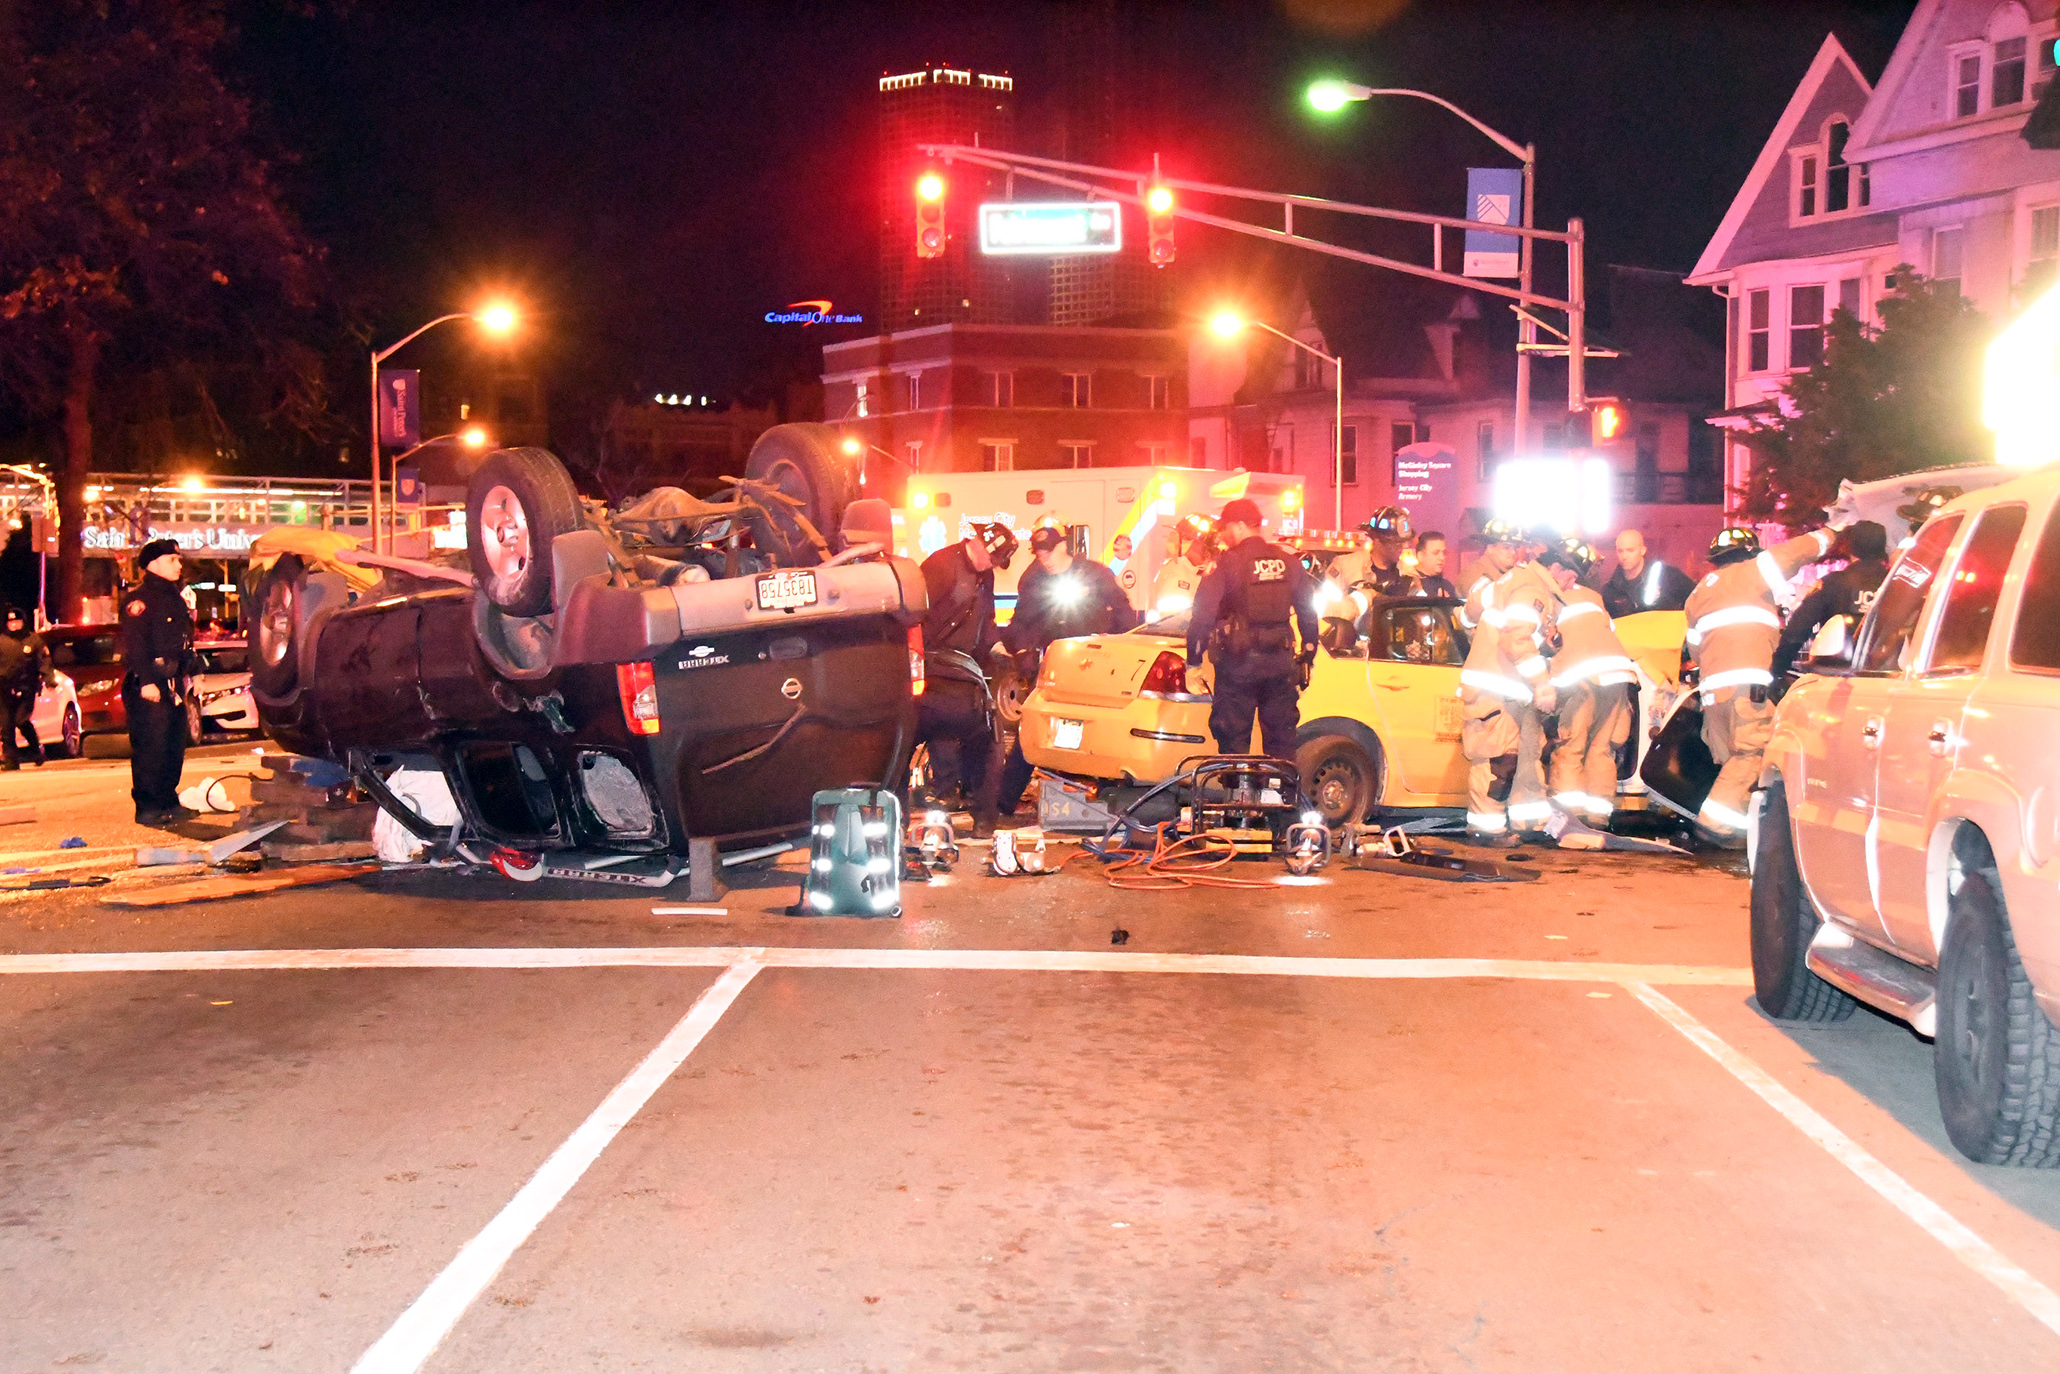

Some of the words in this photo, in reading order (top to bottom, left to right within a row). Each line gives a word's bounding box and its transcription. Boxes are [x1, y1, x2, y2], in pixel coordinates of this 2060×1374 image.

[764, 311, 812, 323] Capital
[835, 314, 863, 323] Bank
[1398, 470, 1430, 478] Shopping
[84, 526, 132, 549] Sain
[1253, 559, 1286, 574] JCPD
